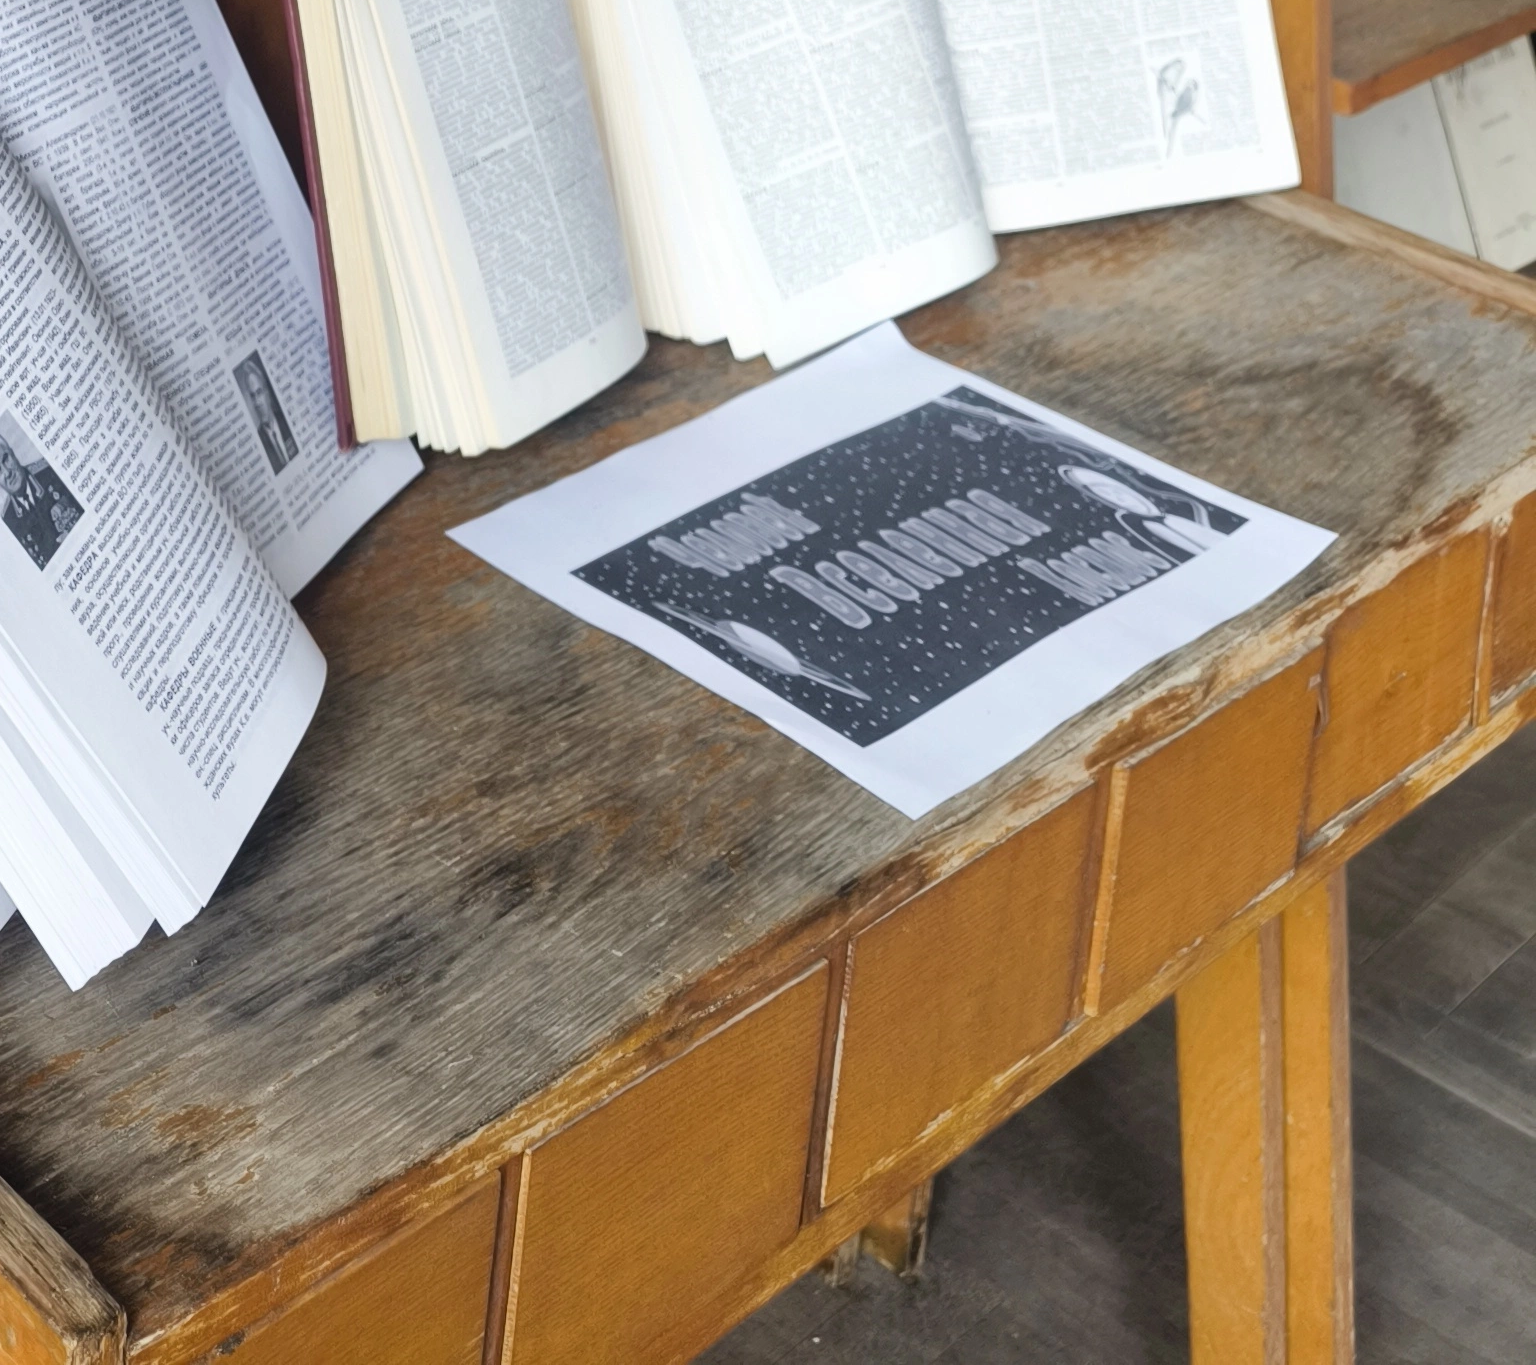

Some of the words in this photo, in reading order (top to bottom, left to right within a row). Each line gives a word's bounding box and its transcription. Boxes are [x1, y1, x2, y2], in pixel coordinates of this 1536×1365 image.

[68, 551, 98, 592] КАФЕДРА
[769, 488, 1051, 630] Вселенная
[152, 666, 195, 712] КАФЕДРЫ
[187, 621, 216, 666] ВОЕННЫЕ
